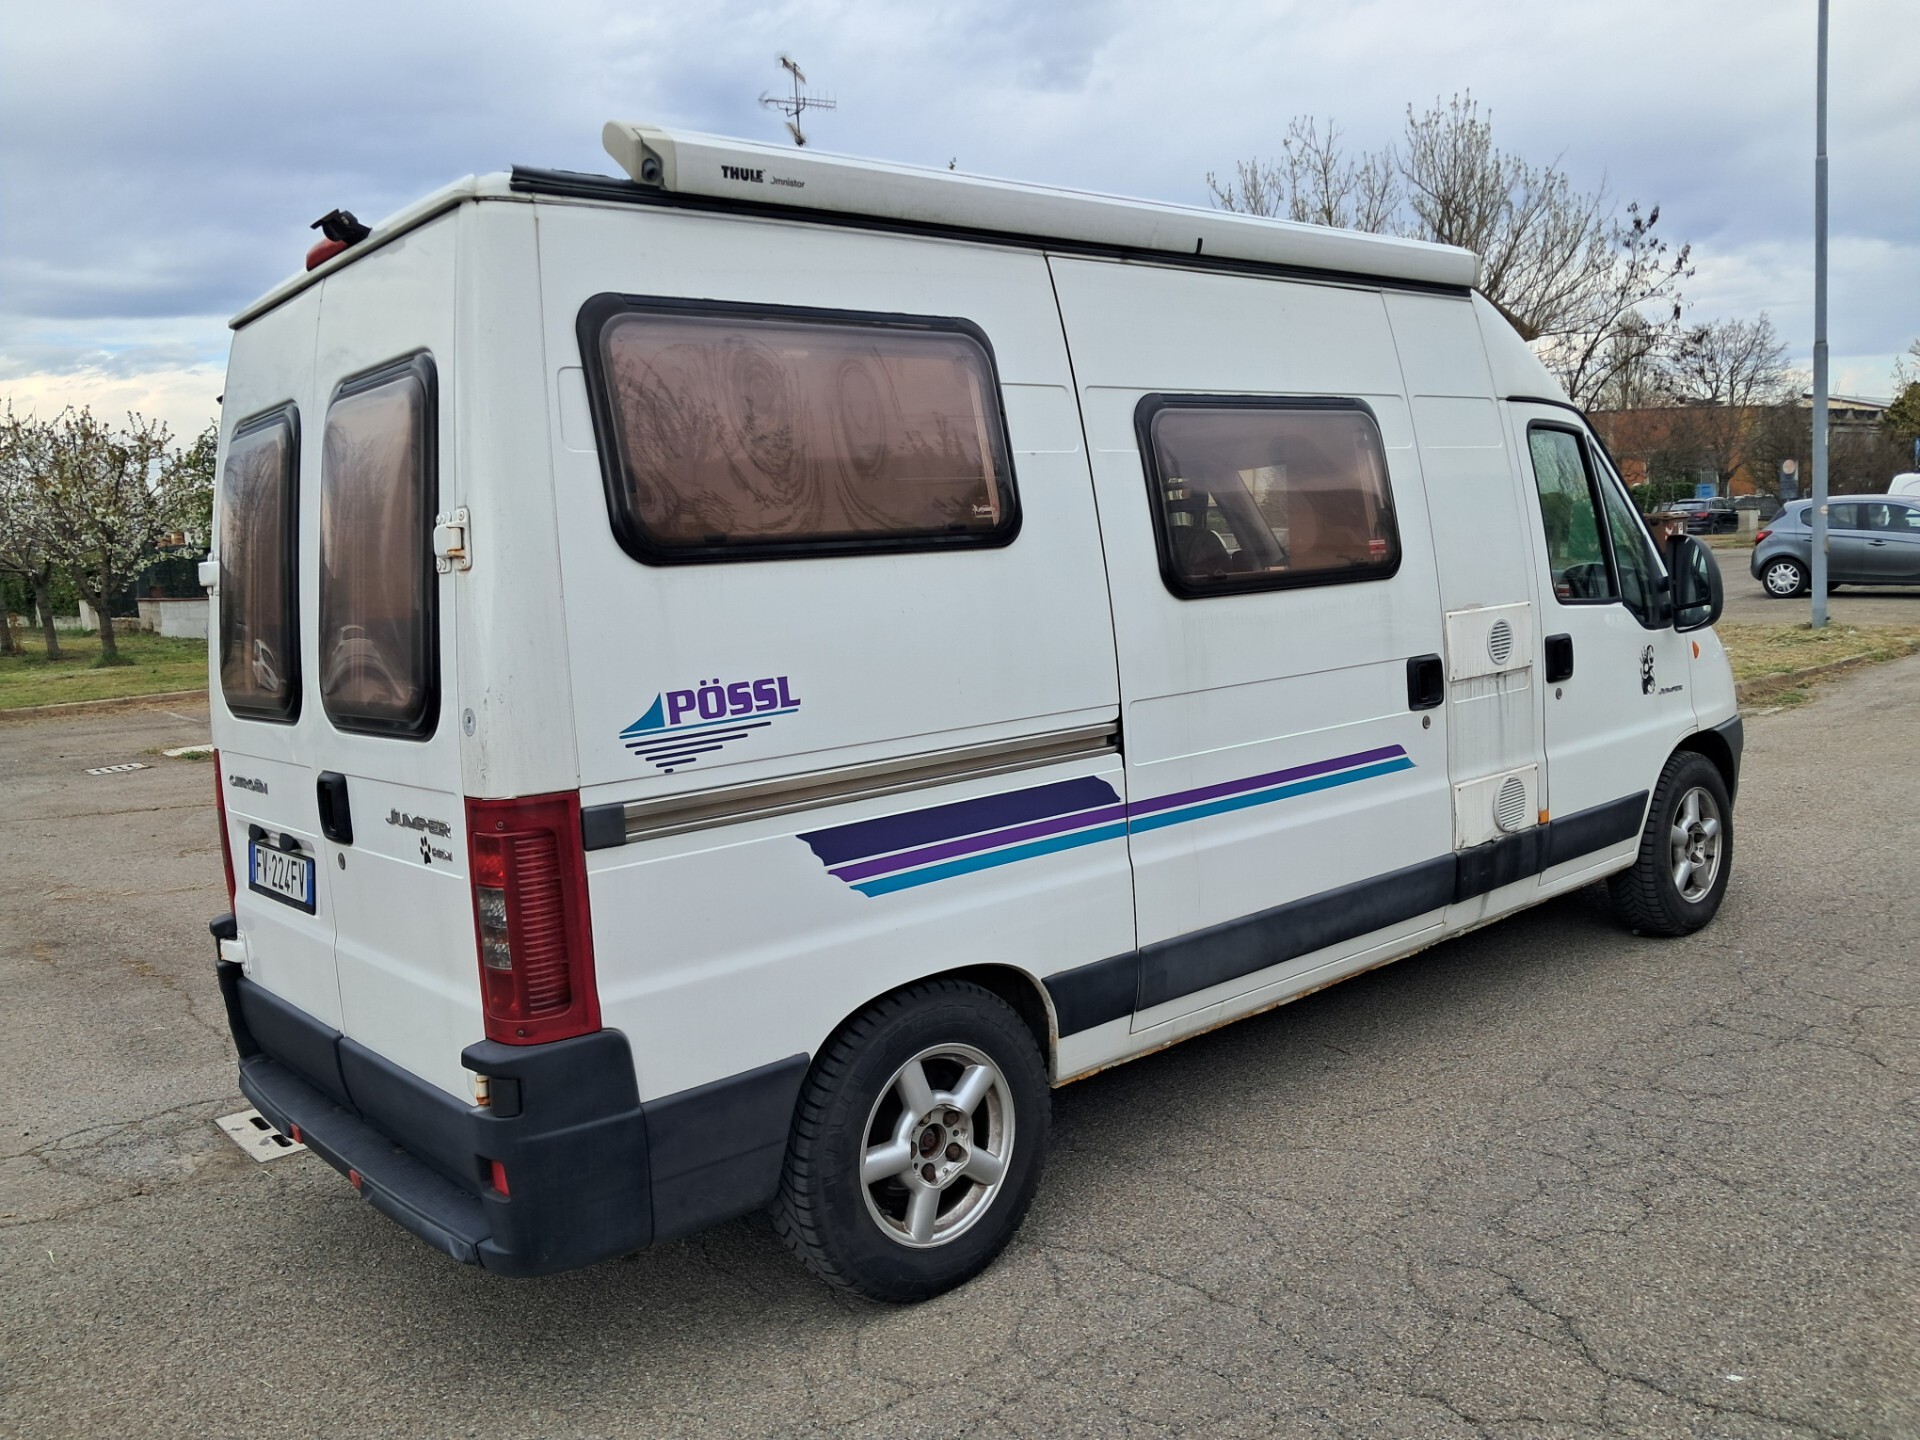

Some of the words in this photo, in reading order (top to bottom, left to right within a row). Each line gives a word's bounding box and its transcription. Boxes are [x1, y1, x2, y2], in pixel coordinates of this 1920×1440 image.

[721, 165, 764, 183] THULE
[666, 676, 801, 725] PÖSSL
[384, 808, 452, 839] JUMPER
